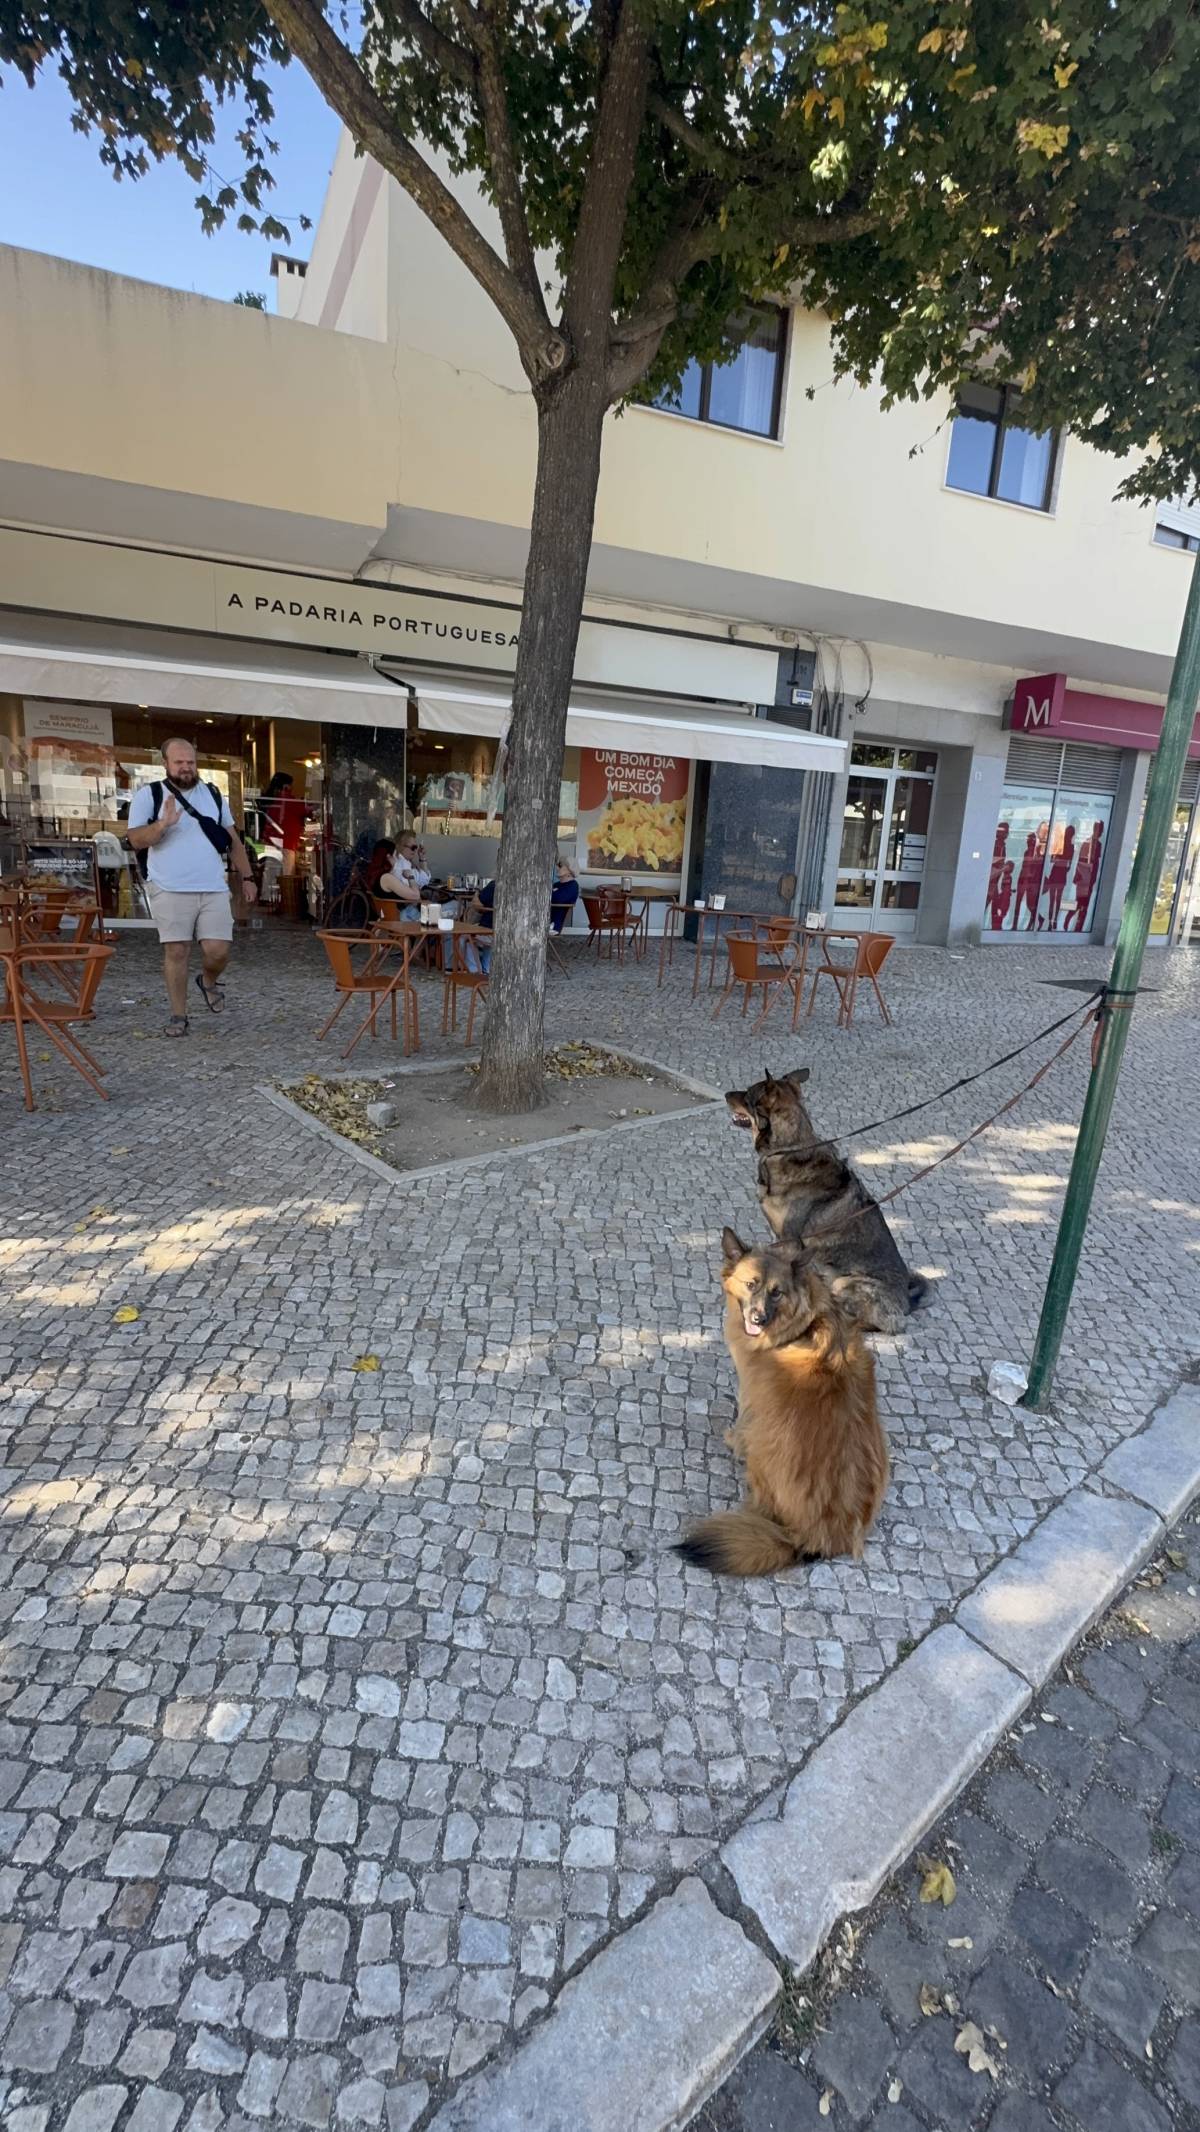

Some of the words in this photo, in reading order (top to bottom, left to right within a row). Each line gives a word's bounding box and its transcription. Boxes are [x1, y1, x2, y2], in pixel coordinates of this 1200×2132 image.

[228, 593, 243, 608] A
[255, 597, 363, 625] PADARIA
[373, 614, 519, 647] PORTUGUESA
[1023, 695, 1050, 727] M
[39, 719, 51, 727] DE
[594, 750, 617, 764] UM
[619, 753, 650, 767] BOM
[653, 756, 676, 770] DIA
[604, 765, 665, 784] COMEÇA
[606, 780, 662, 796] MEXIDO
